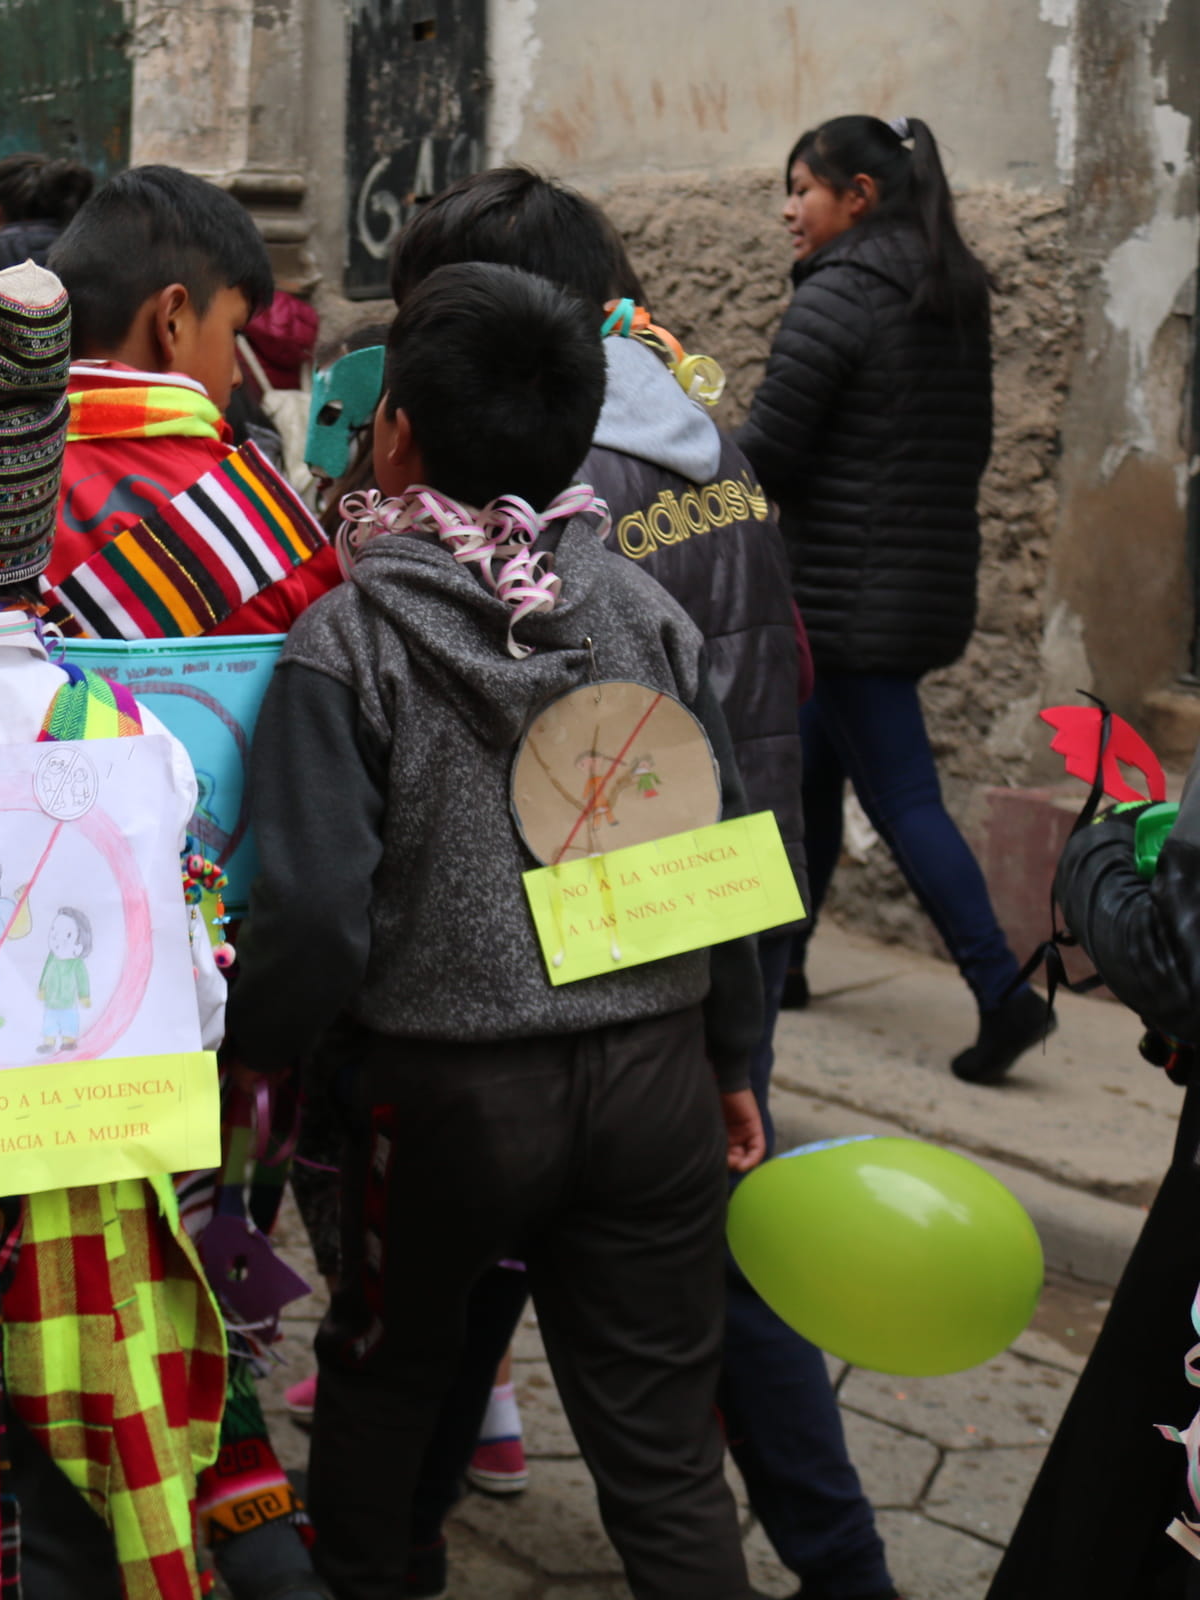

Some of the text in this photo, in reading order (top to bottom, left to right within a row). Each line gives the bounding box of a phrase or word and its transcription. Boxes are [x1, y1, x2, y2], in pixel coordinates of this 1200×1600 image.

[617, 479, 750, 560] adidas
[562, 845, 740, 901] NO A LA VIOLENCIA
[568, 876, 761, 938] A LAS NIÑAS Y NIÑOS
[18, 1093, 31, 1109] A
[40, 1090, 63, 1106] LA
[73, 1079, 176, 1102] VIOLENCIA
[54, 1130, 77, 1146] LA
[88, 1121, 151, 1142] MUJER
